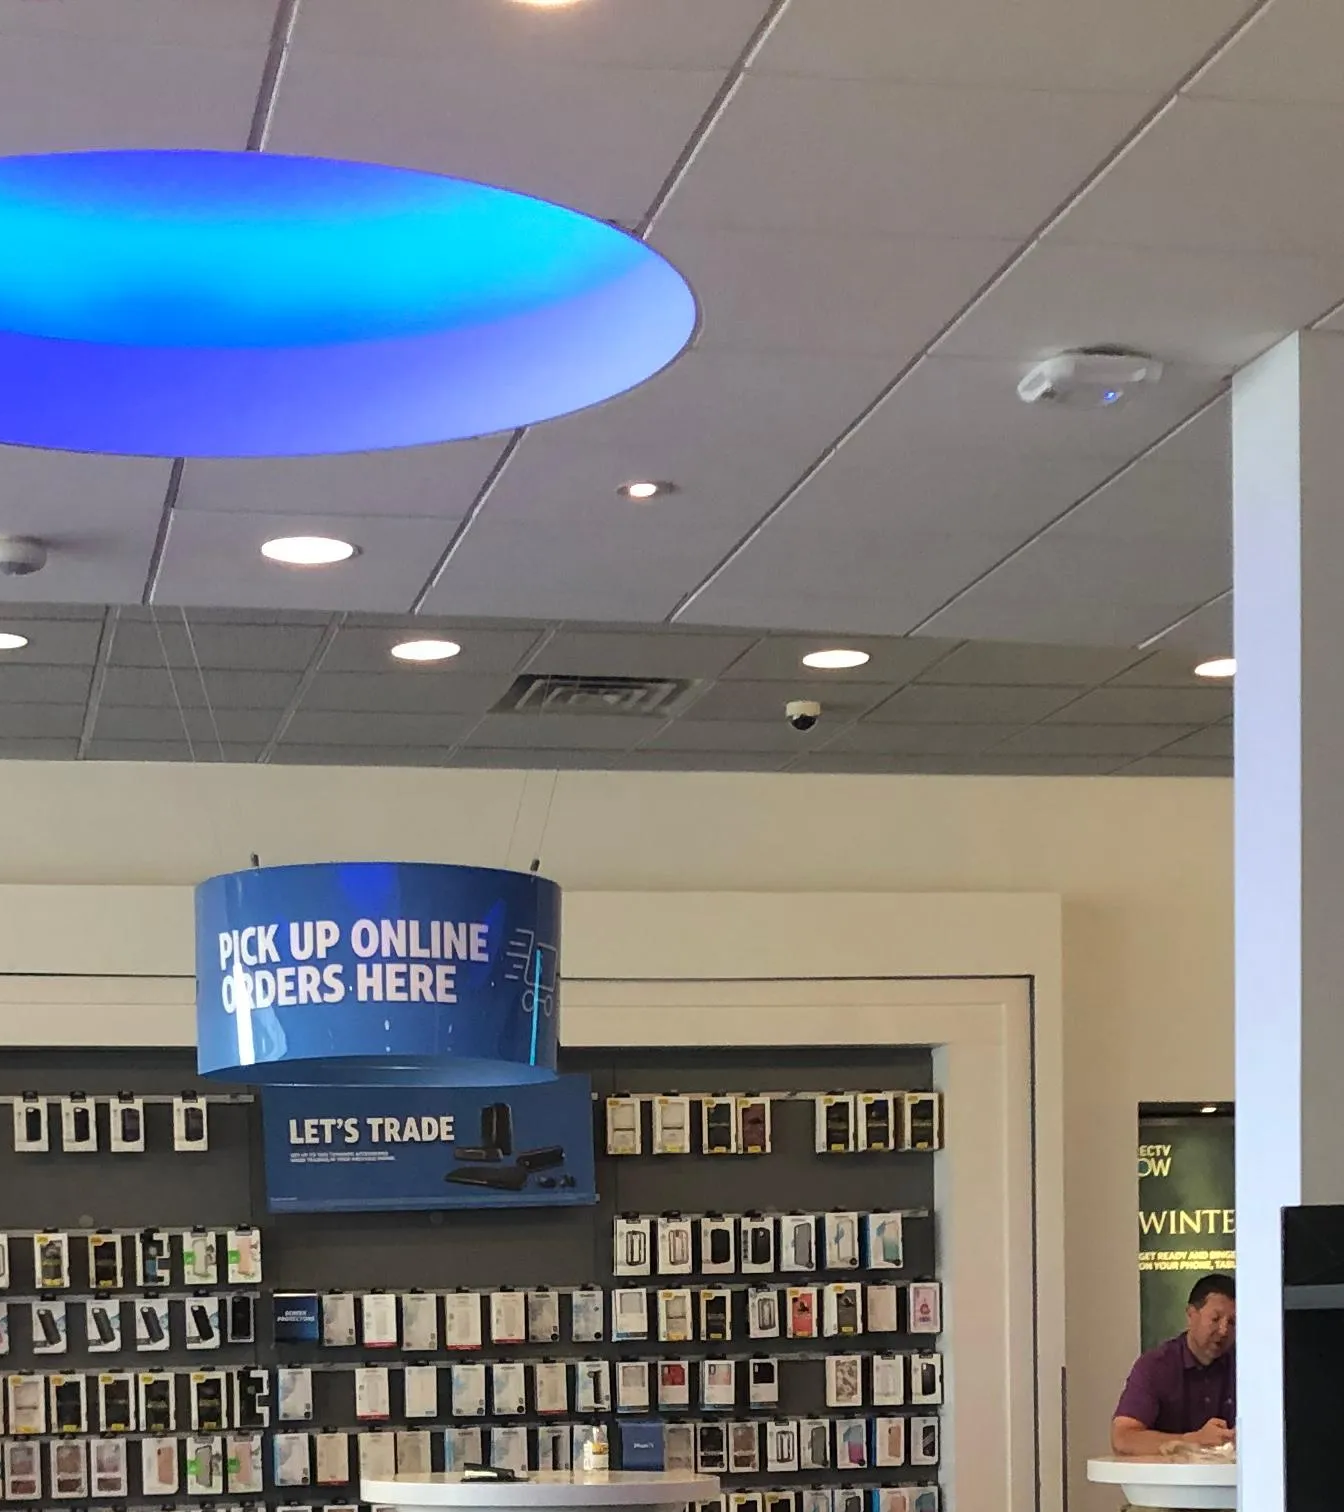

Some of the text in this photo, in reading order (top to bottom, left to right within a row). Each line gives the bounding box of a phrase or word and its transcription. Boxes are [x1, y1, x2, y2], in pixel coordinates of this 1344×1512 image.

[218, 917, 489, 971] PICK UP ONLINE
[221, 964, 457, 1014] ORDERS HERE
[289, 1116, 455, 1145] LET'S TRADE
[1138, 1261, 1153, 1270] ON
[1154, 1261, 1178, 1270] YOUR
[1157, 1251, 1187, 1260] READY
[1187, 1251, 1208, 1260] AND
